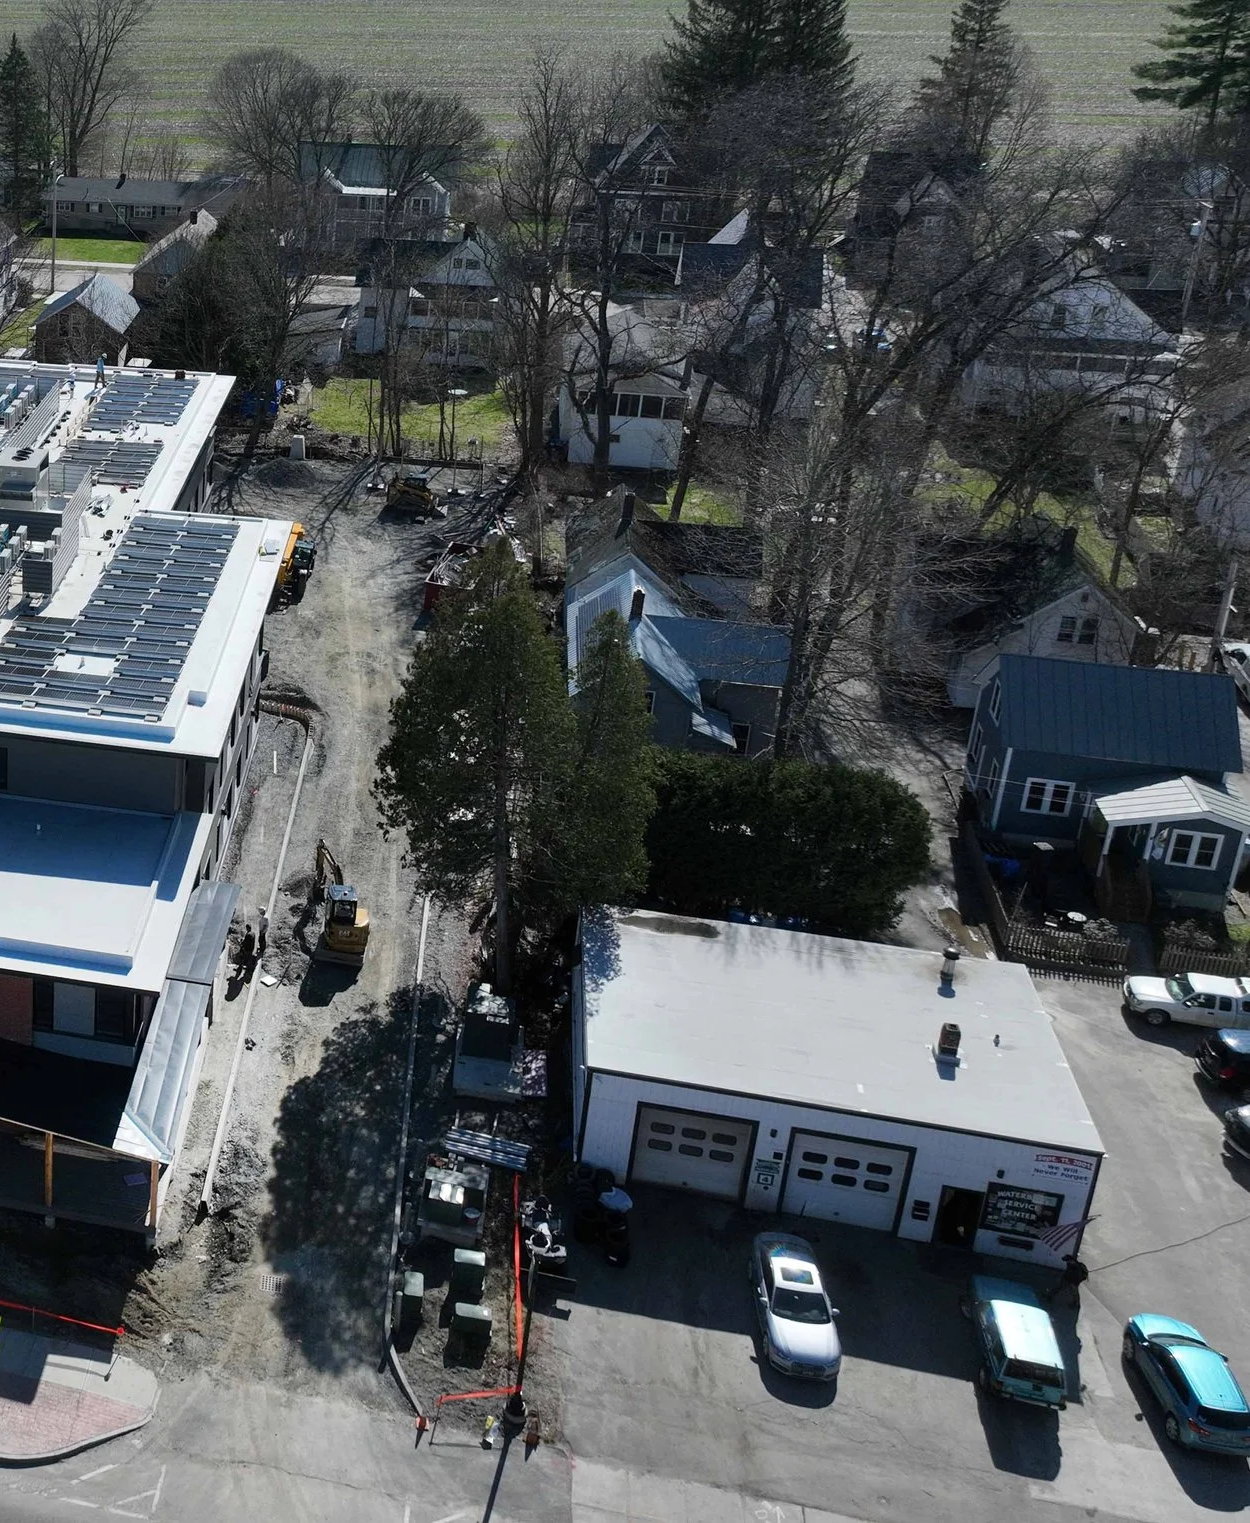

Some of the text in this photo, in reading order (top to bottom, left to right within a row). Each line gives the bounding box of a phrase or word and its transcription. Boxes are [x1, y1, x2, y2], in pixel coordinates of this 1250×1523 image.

[1073, 1160, 1091, 1168] 2001
[1033, 1168, 1089, 1181] Never Forget
[1002, 1209, 1037, 1220] CENTER
